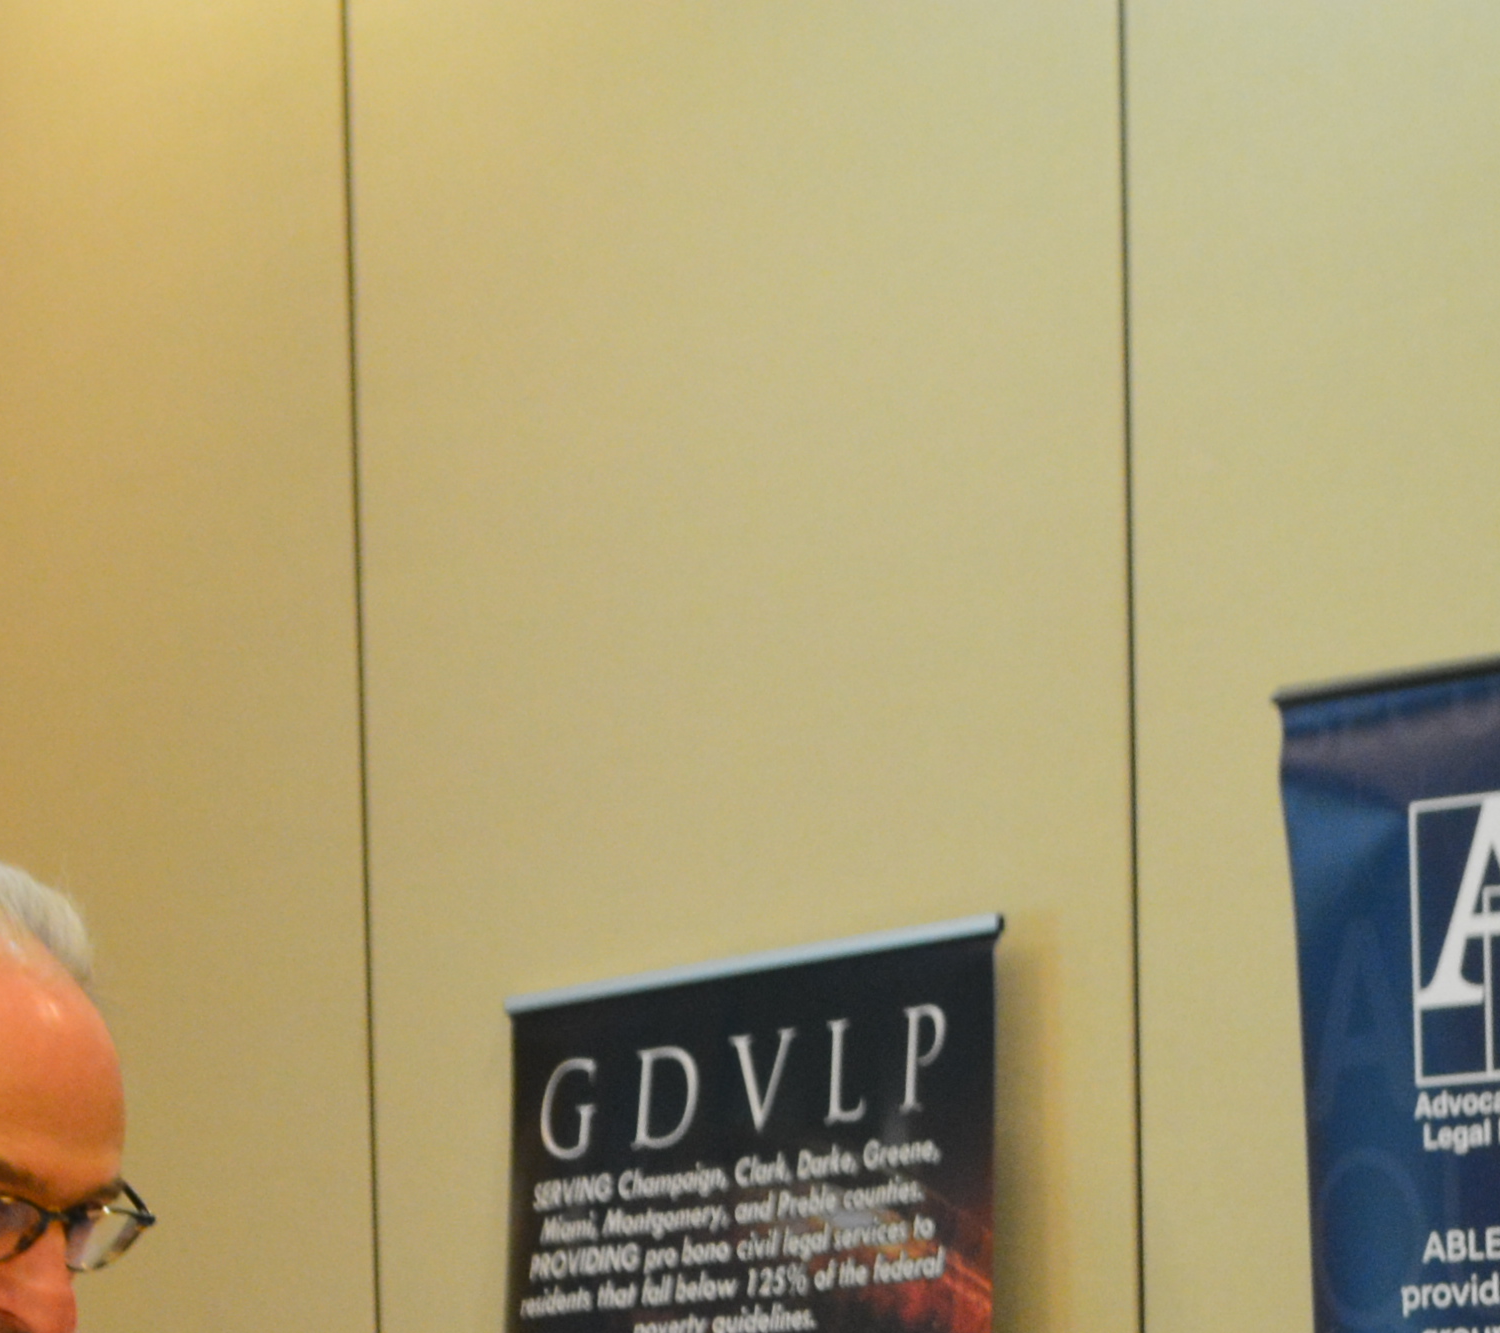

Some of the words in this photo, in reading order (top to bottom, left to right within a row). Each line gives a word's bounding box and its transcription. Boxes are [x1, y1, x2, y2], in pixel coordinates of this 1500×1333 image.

[1423, 1118, 1491, 1155] Legal
[533, 1172, 614, 1212] SERVING
[618, 1161, 729, 1201] Champaign,
[735, 1151, 792, 1188] Clark,
[797, 1143, 858, 1181] Darke,
[863, 1138, 942, 1171] Greene,
[602, 1205, 730, 1241] Montgomery,
[735, 1189, 774, 1225] and
[778, 1182, 838, 1219] Preble
[520, 1285, 593, 1319] residents
[597, 1279, 637, 1308] that
[642, 1274, 674, 1306] fall
[675, 1270, 738, 1304] below
[747, 1261, 809, 1297] 125%
[814, 1257, 836, 1292] of
[839, 1255, 870, 1289] the
[873, 1245, 946, 1284] federal
[529, 1242, 640, 1282] PROVIDING
[644, 1247, 678, 1276] pro
[682, 1234, 730, 1266] bono
[737, 1226, 780, 1261] civil
[783, 1220, 831, 1262] legal
[834, 1215, 908, 1251] services
[913, 1213, 935, 1240] to
